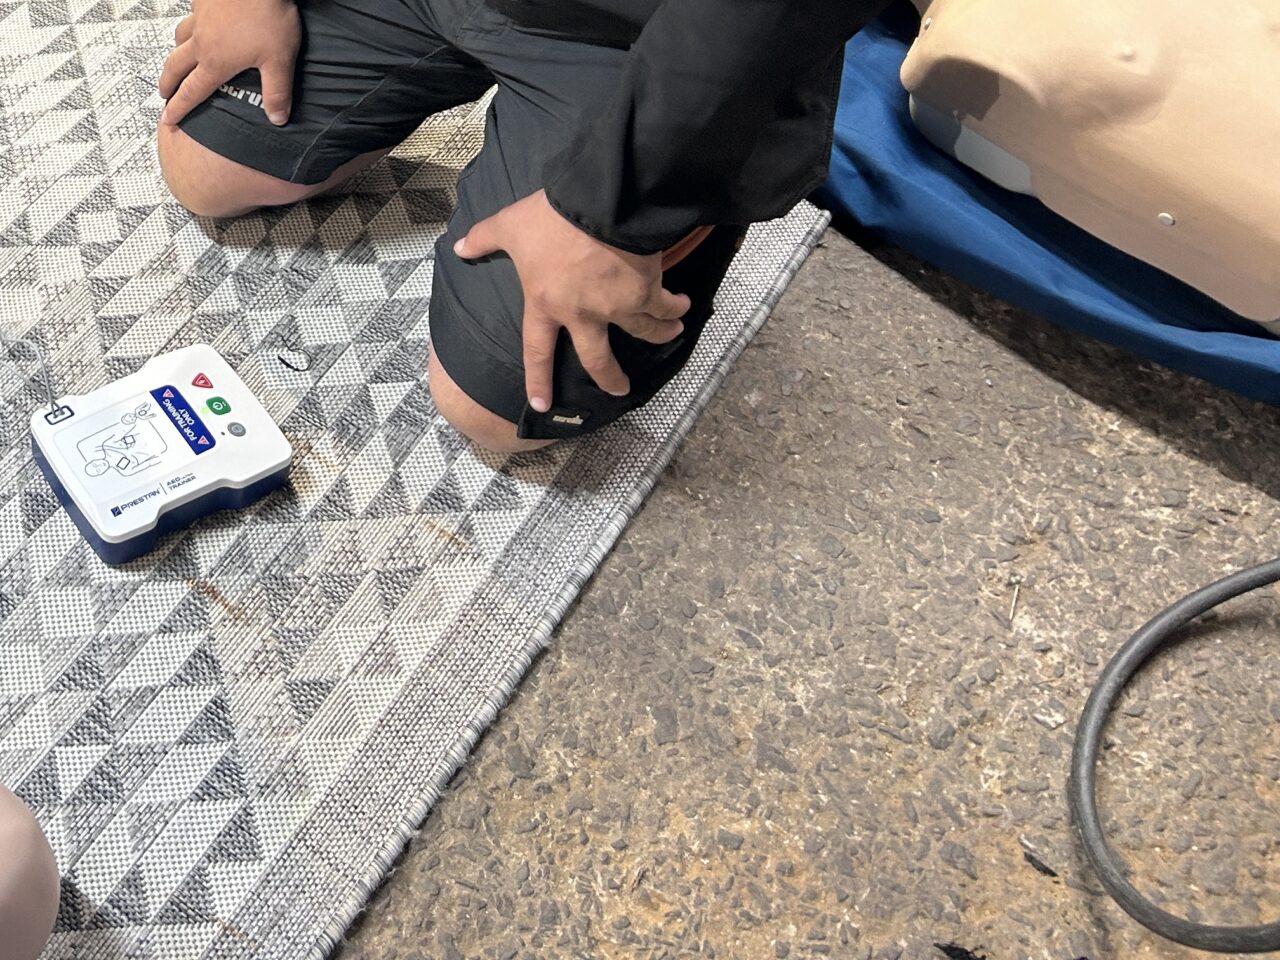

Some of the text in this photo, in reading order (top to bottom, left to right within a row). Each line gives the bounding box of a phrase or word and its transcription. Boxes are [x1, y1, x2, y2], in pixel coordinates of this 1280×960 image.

[162, 398, 198, 442] FOR TRAINING
[178, 408, 196, 426] ONLY
[120, 489, 160, 513] PRESTAN
